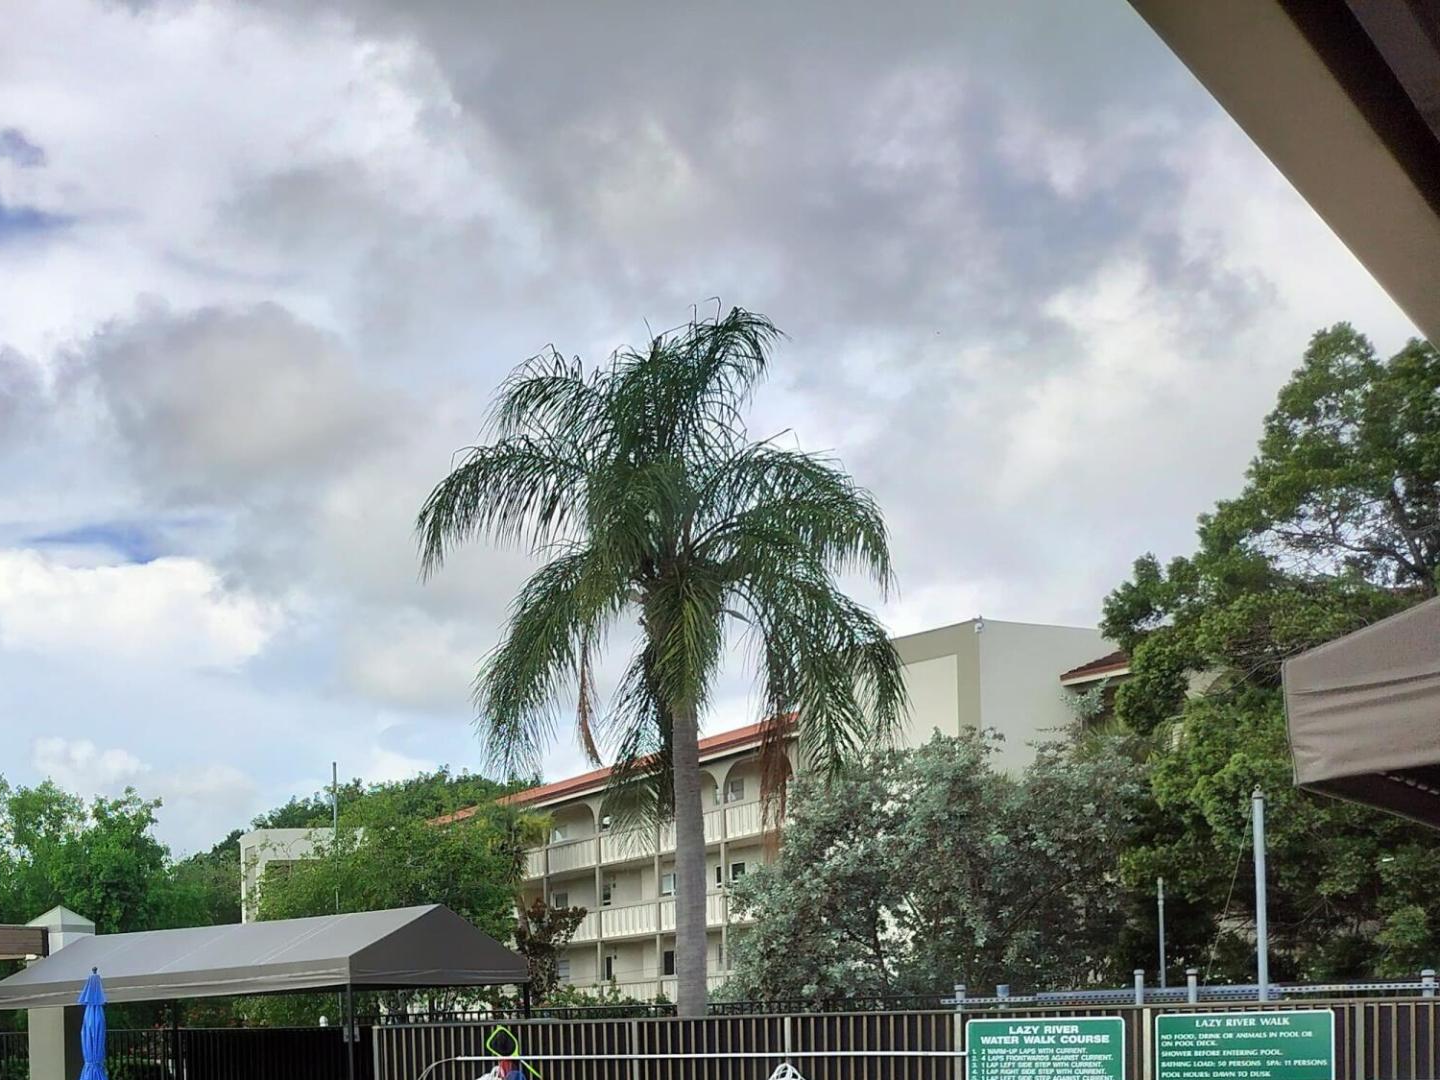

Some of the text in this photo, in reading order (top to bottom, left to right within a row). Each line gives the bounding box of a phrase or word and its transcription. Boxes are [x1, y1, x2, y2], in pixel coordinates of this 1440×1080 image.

[1194, 1016, 1290, 1028] LAZY RIVER WALK
[1008, 1024, 1079, 1034] LAZY RIVER
[980, 1034, 1110, 1044] WATER WALK COURSE
